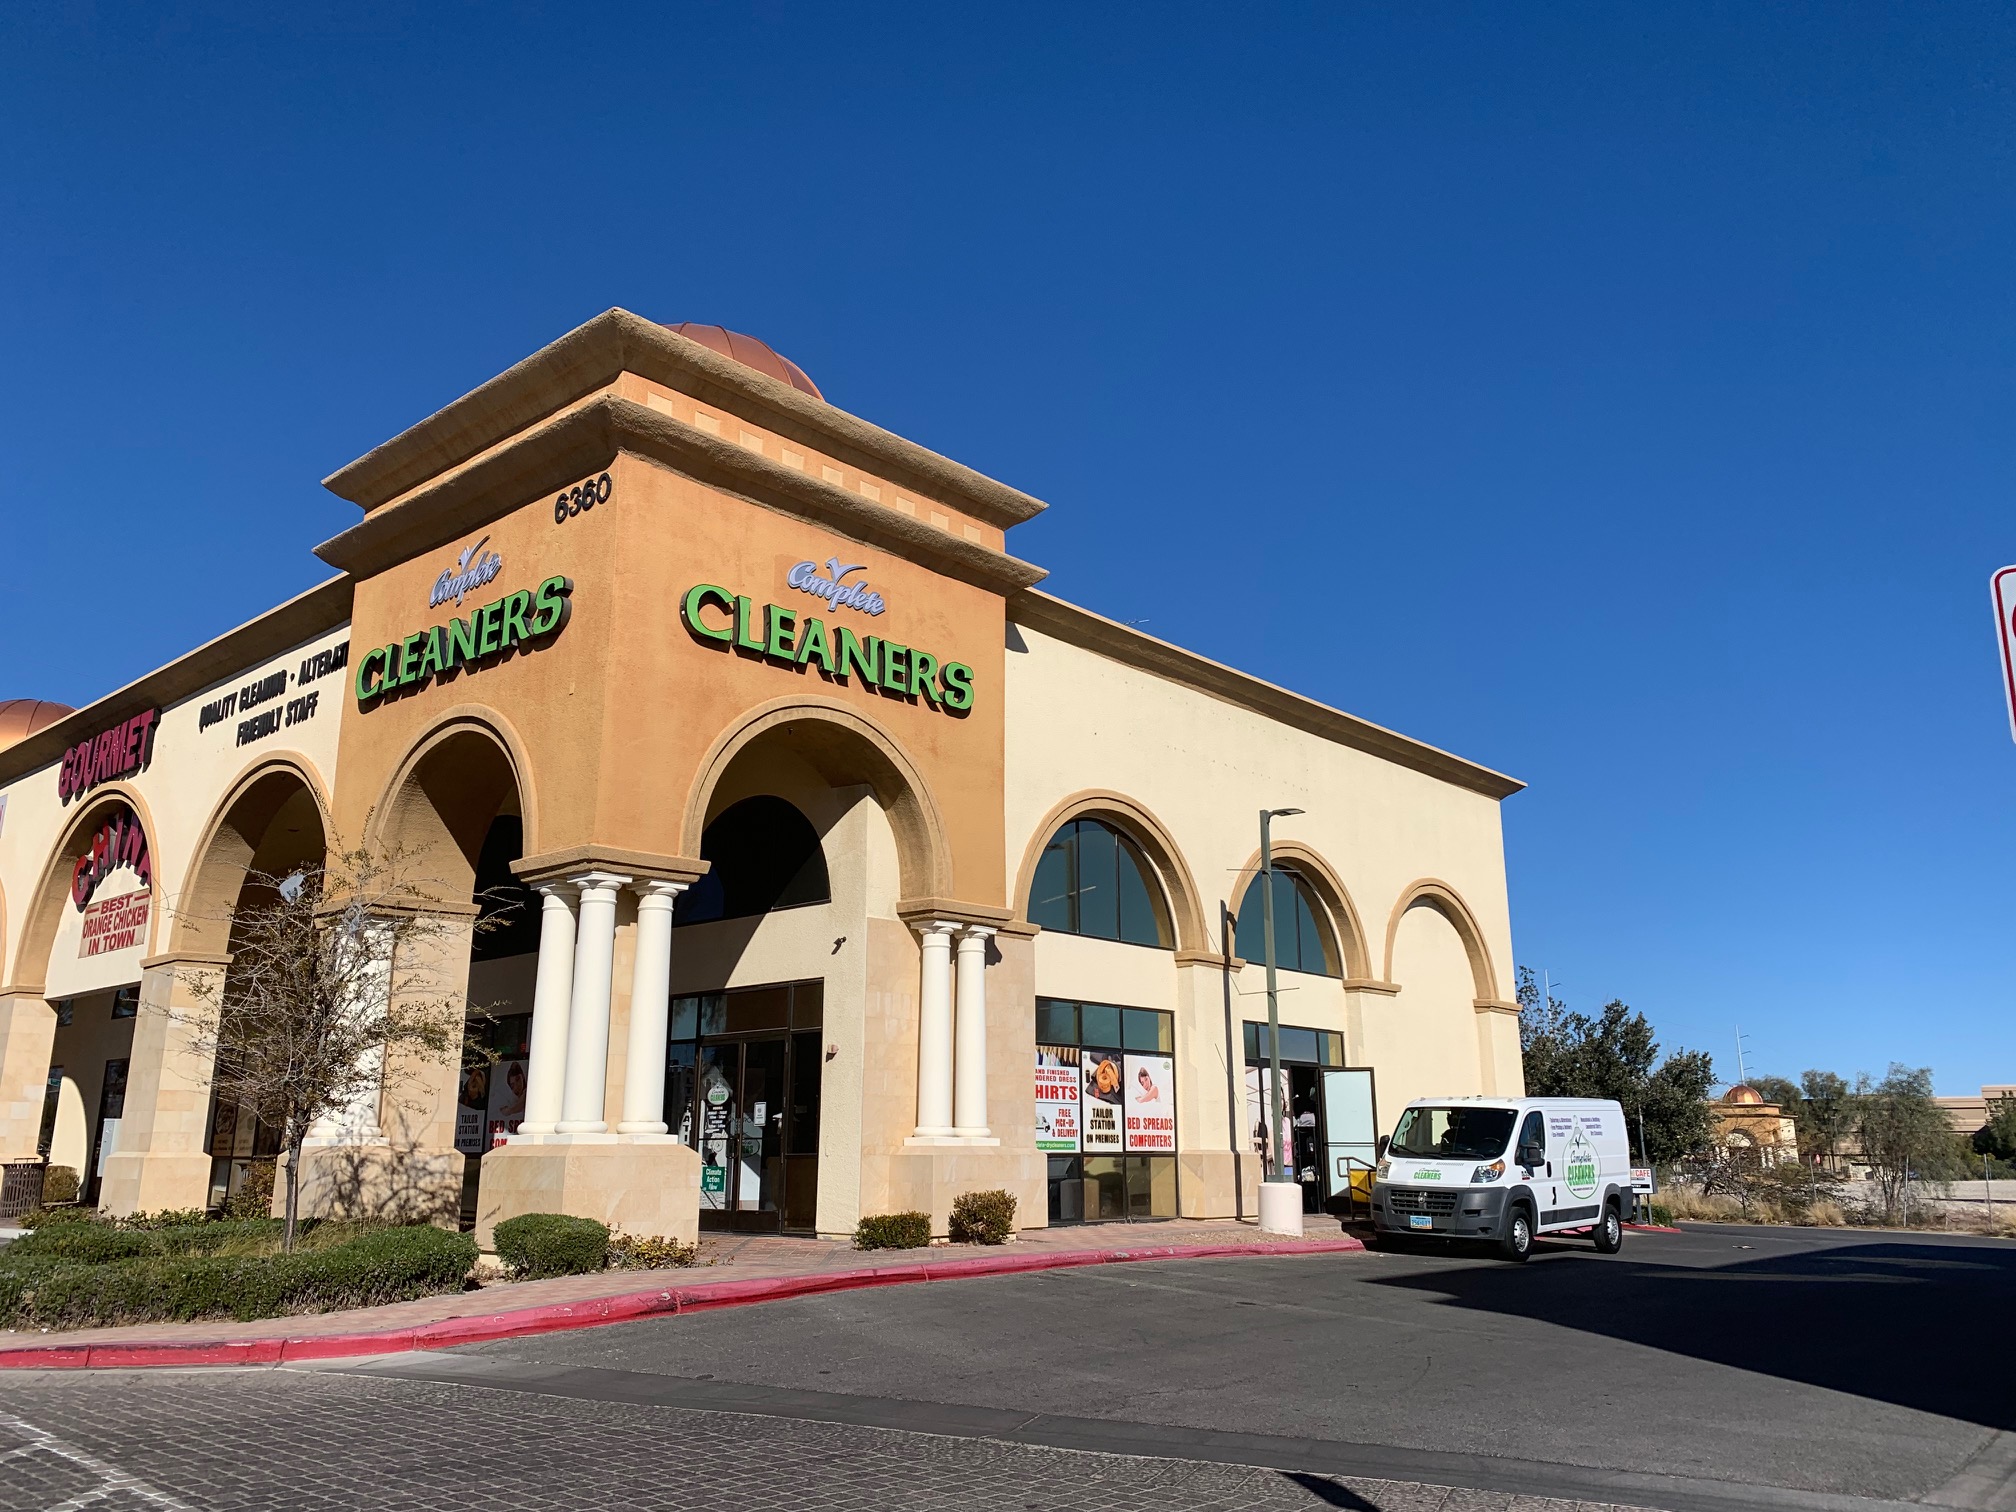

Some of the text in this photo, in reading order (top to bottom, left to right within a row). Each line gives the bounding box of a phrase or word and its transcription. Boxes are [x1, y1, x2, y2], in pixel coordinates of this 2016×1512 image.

[554, 472, 613, 524] 6360
[429, 548, 503, 608] Complete
[786, 559, 886, 617] Complete
[355, 575, 570, 704] CLEANERS
[681, 583, 975, 713] CLEANERS
[199, 691, 238, 734] QUALITY
[239, 669, 288, 713] CLEANING
[236, 690, 319, 748] FRIENDLY STAFF
[58, 707, 158, 803] GOURMET
[72, 805, 152, 908] CHINA
[100, 893, 134, 915] BEST
[82, 904, 149, 940] ORANGE CHICKEN
[87, 929, 136, 955] IN TOWN
[461, 1114, 479, 1124] TAILOR
[1058, 1108, 1072, 1118] FREE
[1092, 1107, 1114, 1119] TAILOR
[458, 1125, 479, 1135] STATION
[488, 1120, 505, 1134] BED
[1055, 1119, 1075, 1128] PICK-UP
[1090, 1119, 1116, 1130] STATION
[1127, 1117, 1173, 1131] BED SPREADS
[1057, 1129, 1078, 1138] DELIVERY
[1086, 1134, 1120, 1144] ON PREMISES
[1129, 1134, 1172, 1148] COMFORTERS
[706, 1168, 722, 1176] Climate
[706, 1175, 720, 1183] Action
[1414, 1172, 1442, 1181] CLEANERS
[1568, 1164, 1595, 1187] CLEANERS
[1635, 1170, 1651, 1178] CAFE
